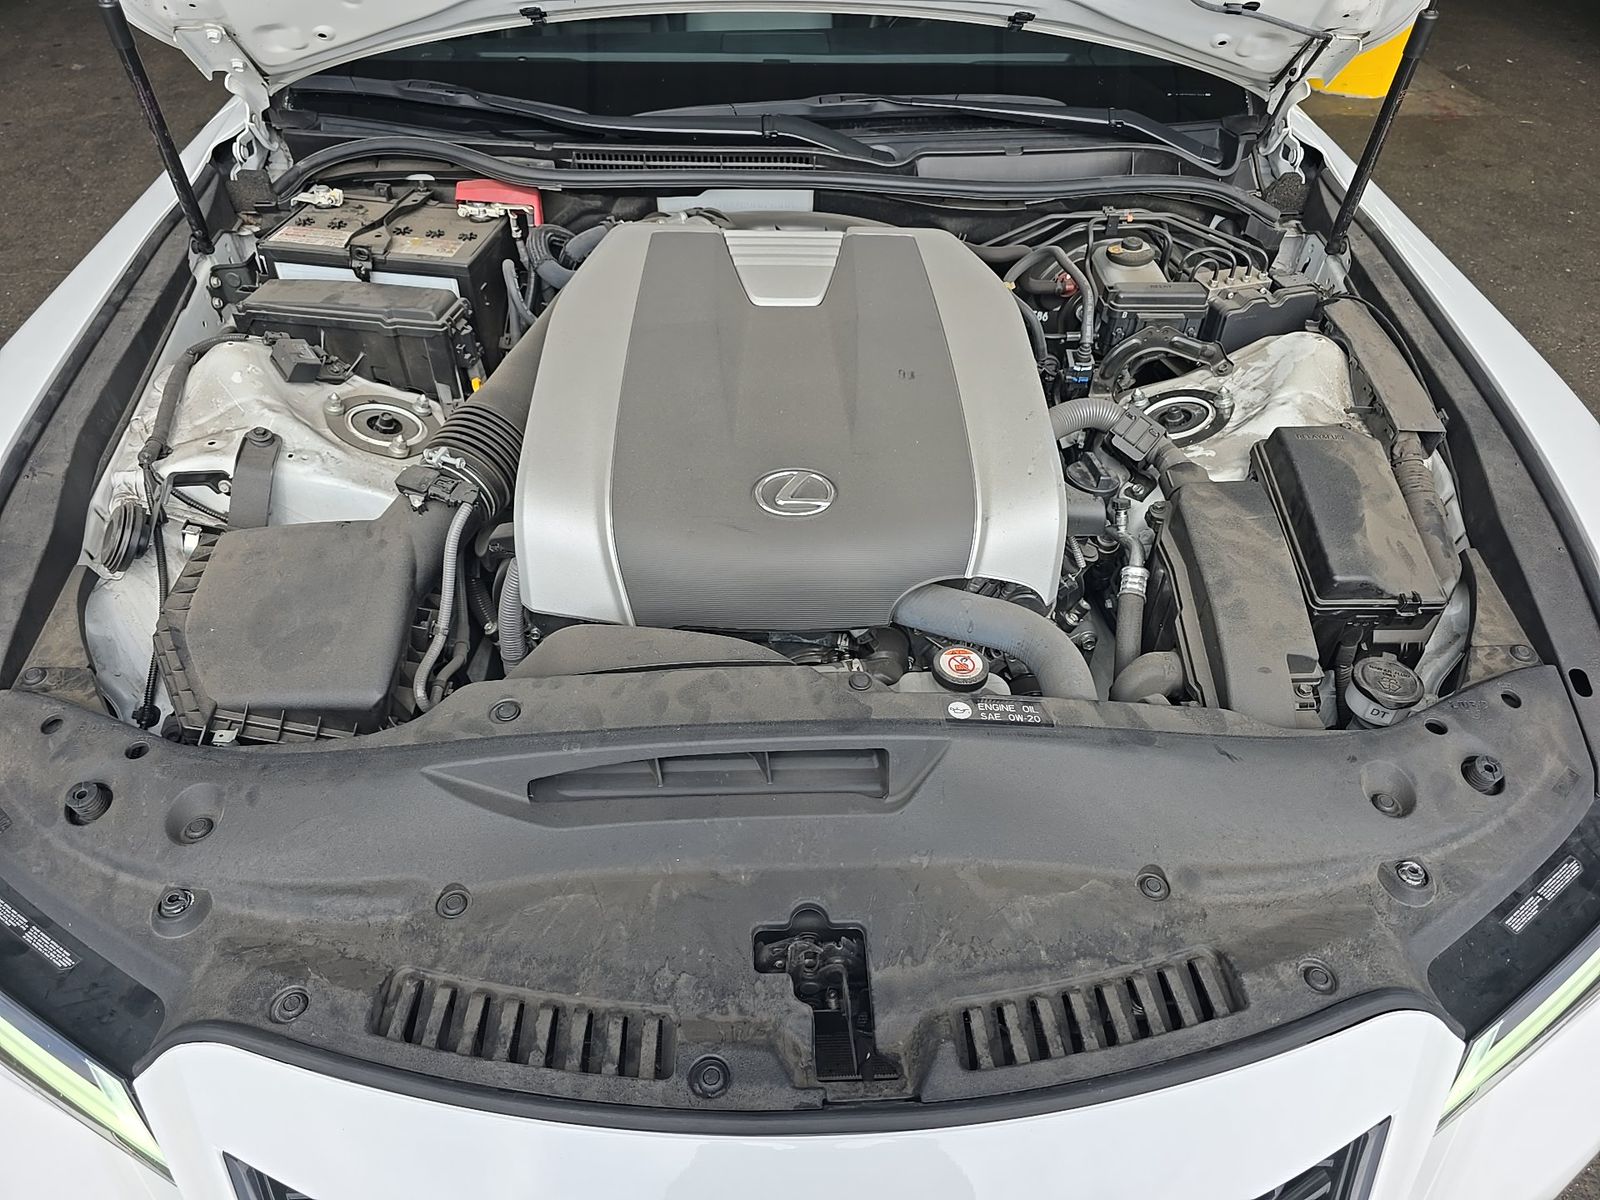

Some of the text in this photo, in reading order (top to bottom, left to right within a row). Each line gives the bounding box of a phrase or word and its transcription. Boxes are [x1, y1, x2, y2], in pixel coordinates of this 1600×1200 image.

[978, 703, 1039, 713] ENGINE OIL
[1370, 708, 1389, 718] DT
[980, 712, 1041, 723] SAE 0W-20
